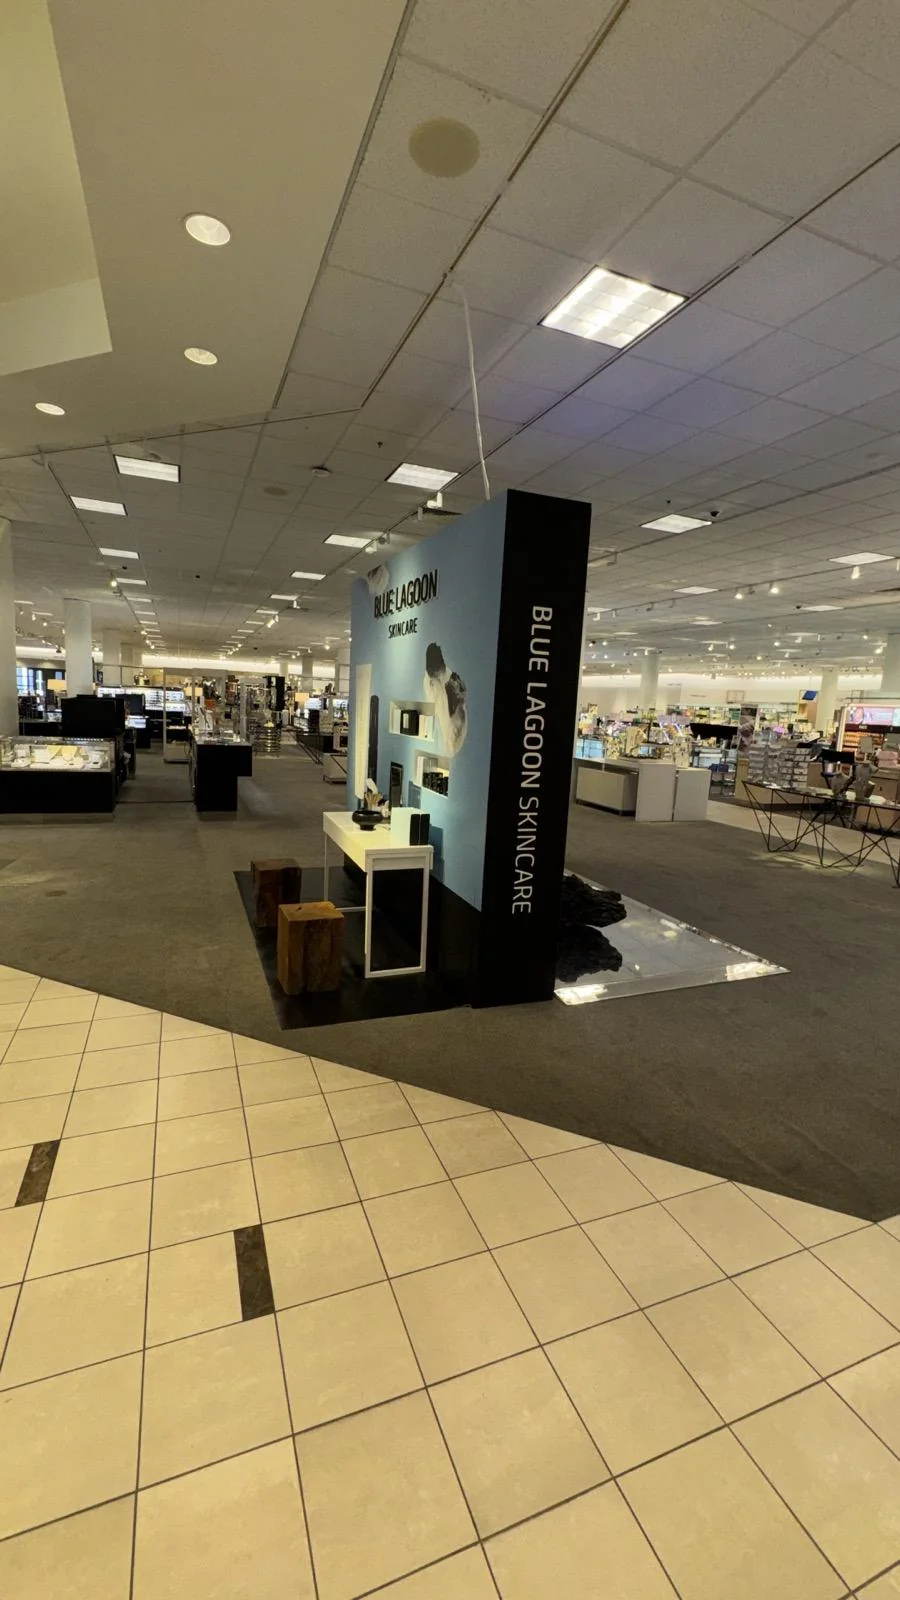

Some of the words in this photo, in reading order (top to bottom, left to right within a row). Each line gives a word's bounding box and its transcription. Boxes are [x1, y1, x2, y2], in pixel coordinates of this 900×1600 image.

[374, 589, 395, 618] BLUE
[396, 569, 438, 610] LAGOON
[389, 618, 418, 638] SKINCARE
[529, 605, 553, 673] BLUE
[521, 682, 547, 788] LAGOON
[512, 797, 539, 914] SKINCARE
